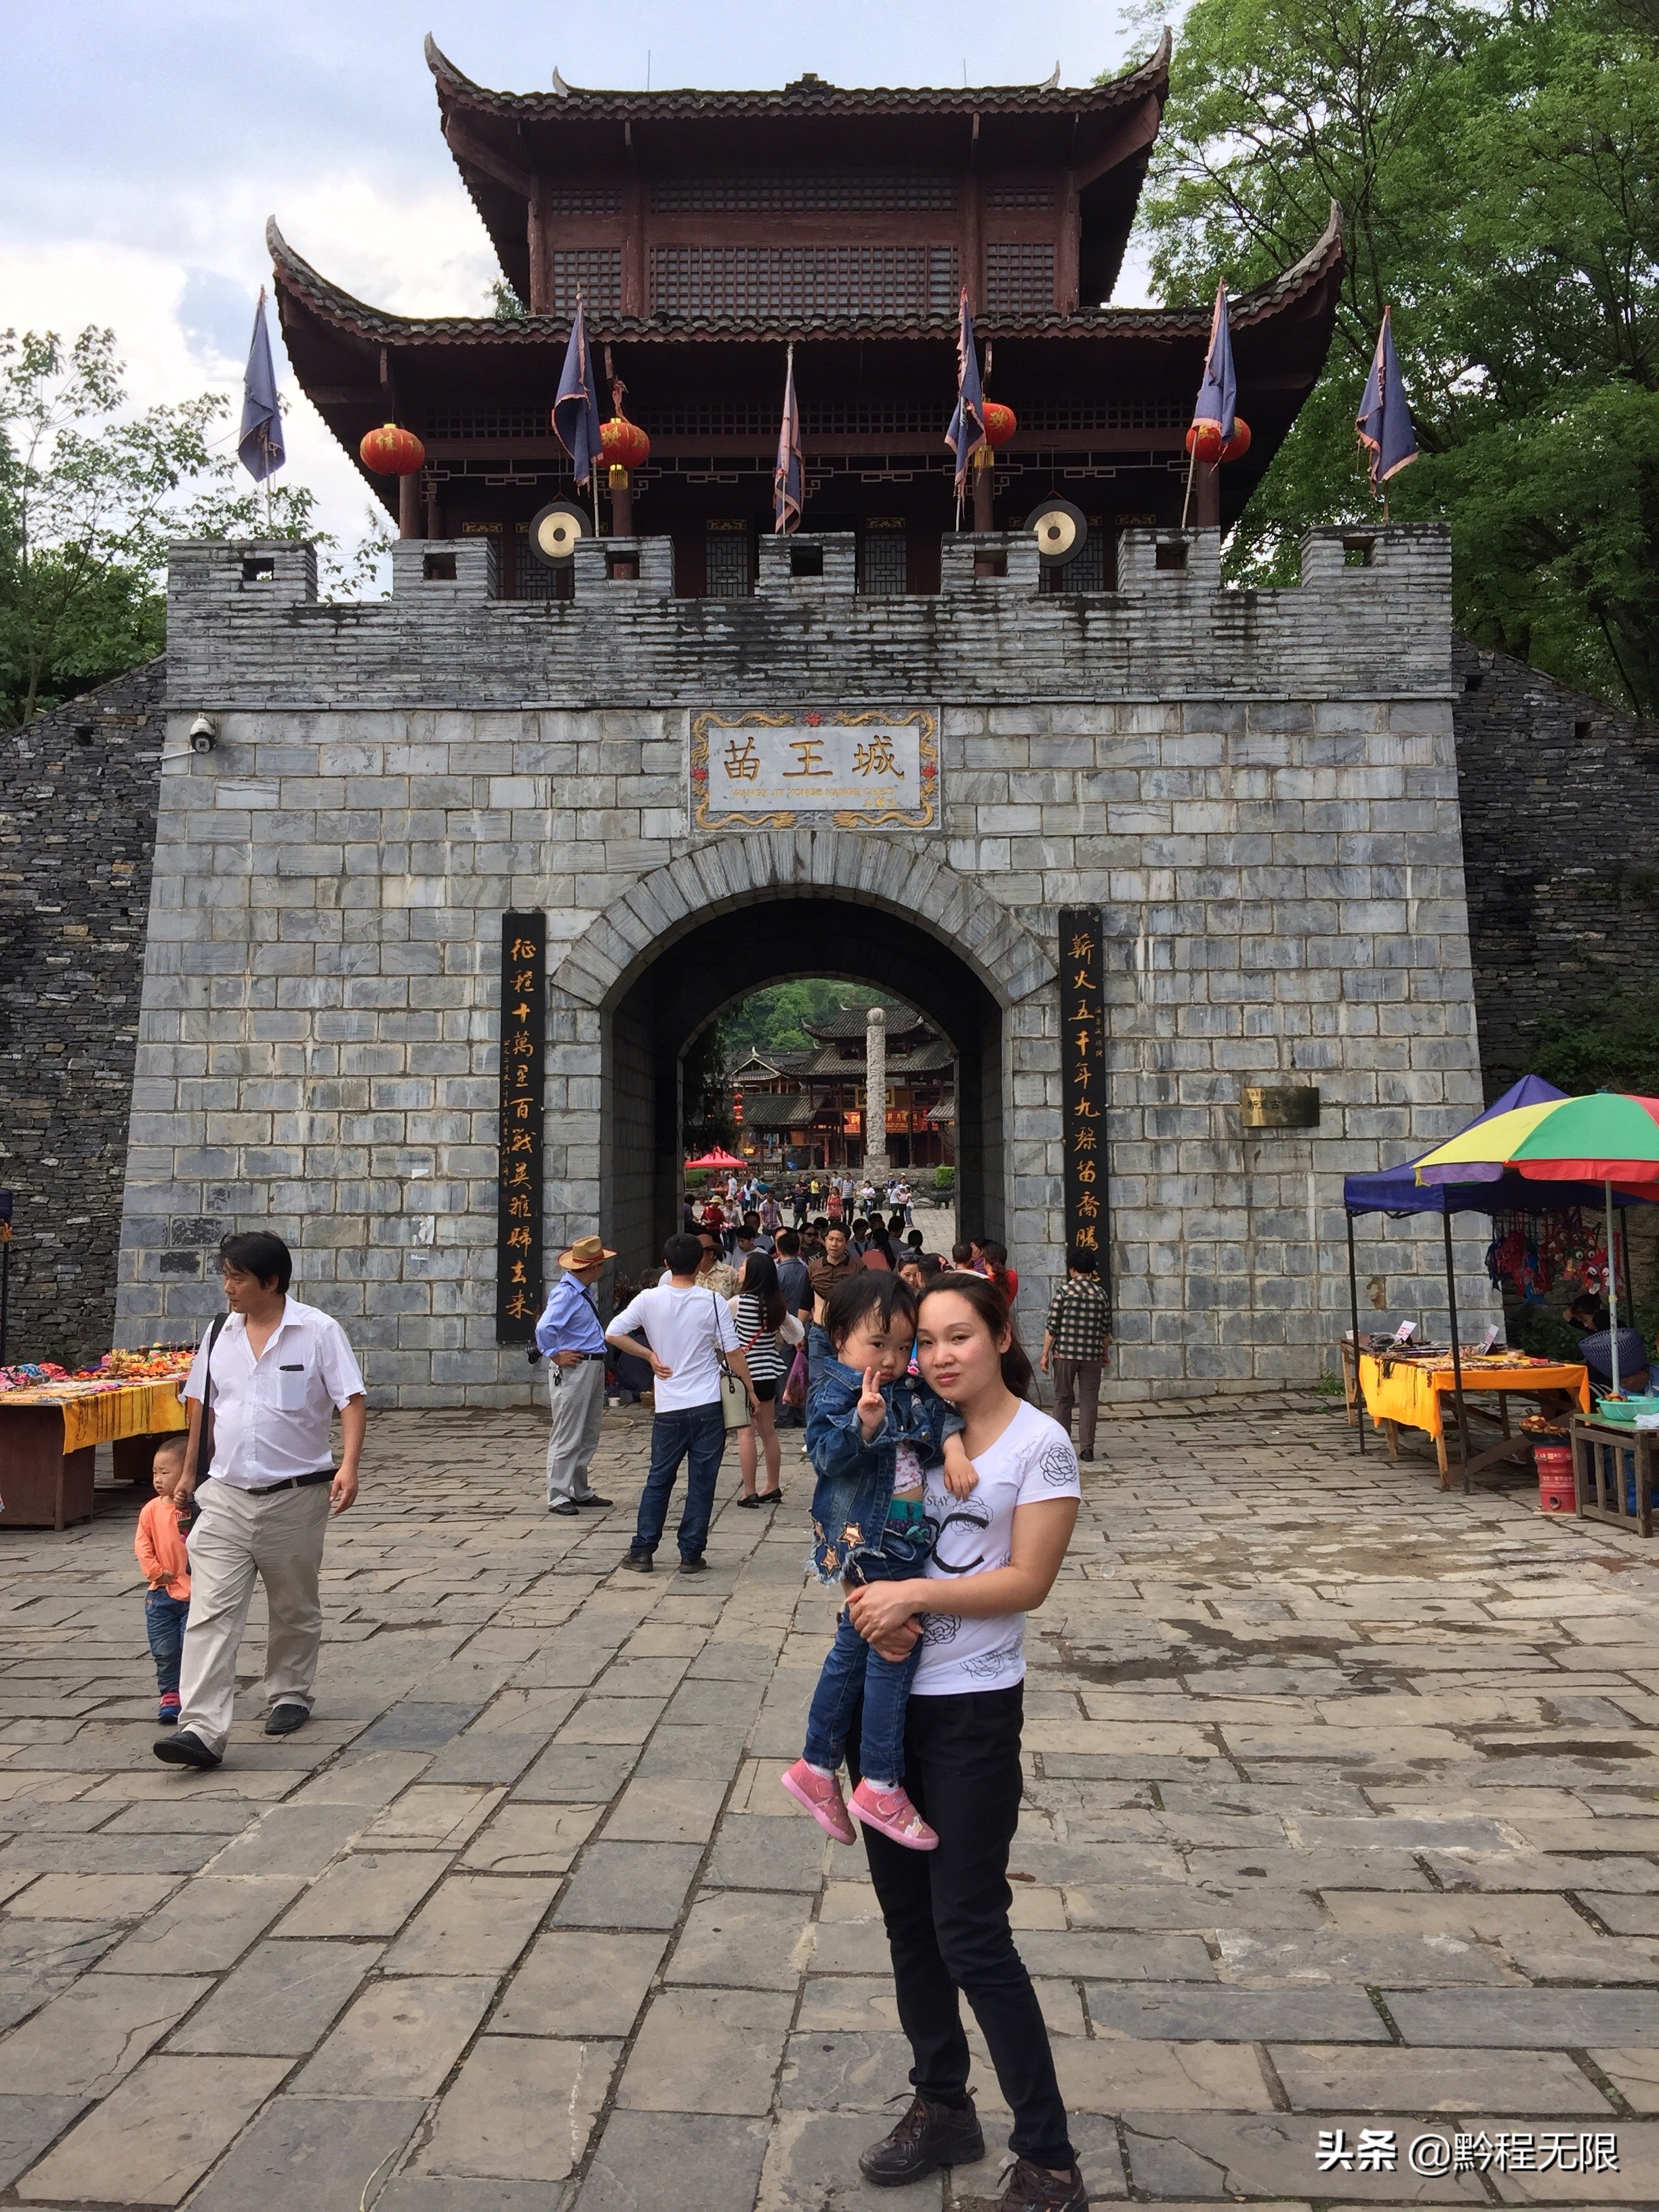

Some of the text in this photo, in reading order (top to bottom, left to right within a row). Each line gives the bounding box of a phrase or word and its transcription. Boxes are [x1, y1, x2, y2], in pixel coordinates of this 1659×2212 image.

[723, 734, 905, 781] 苗王城
[926, 1494, 949, 1507] STAY
